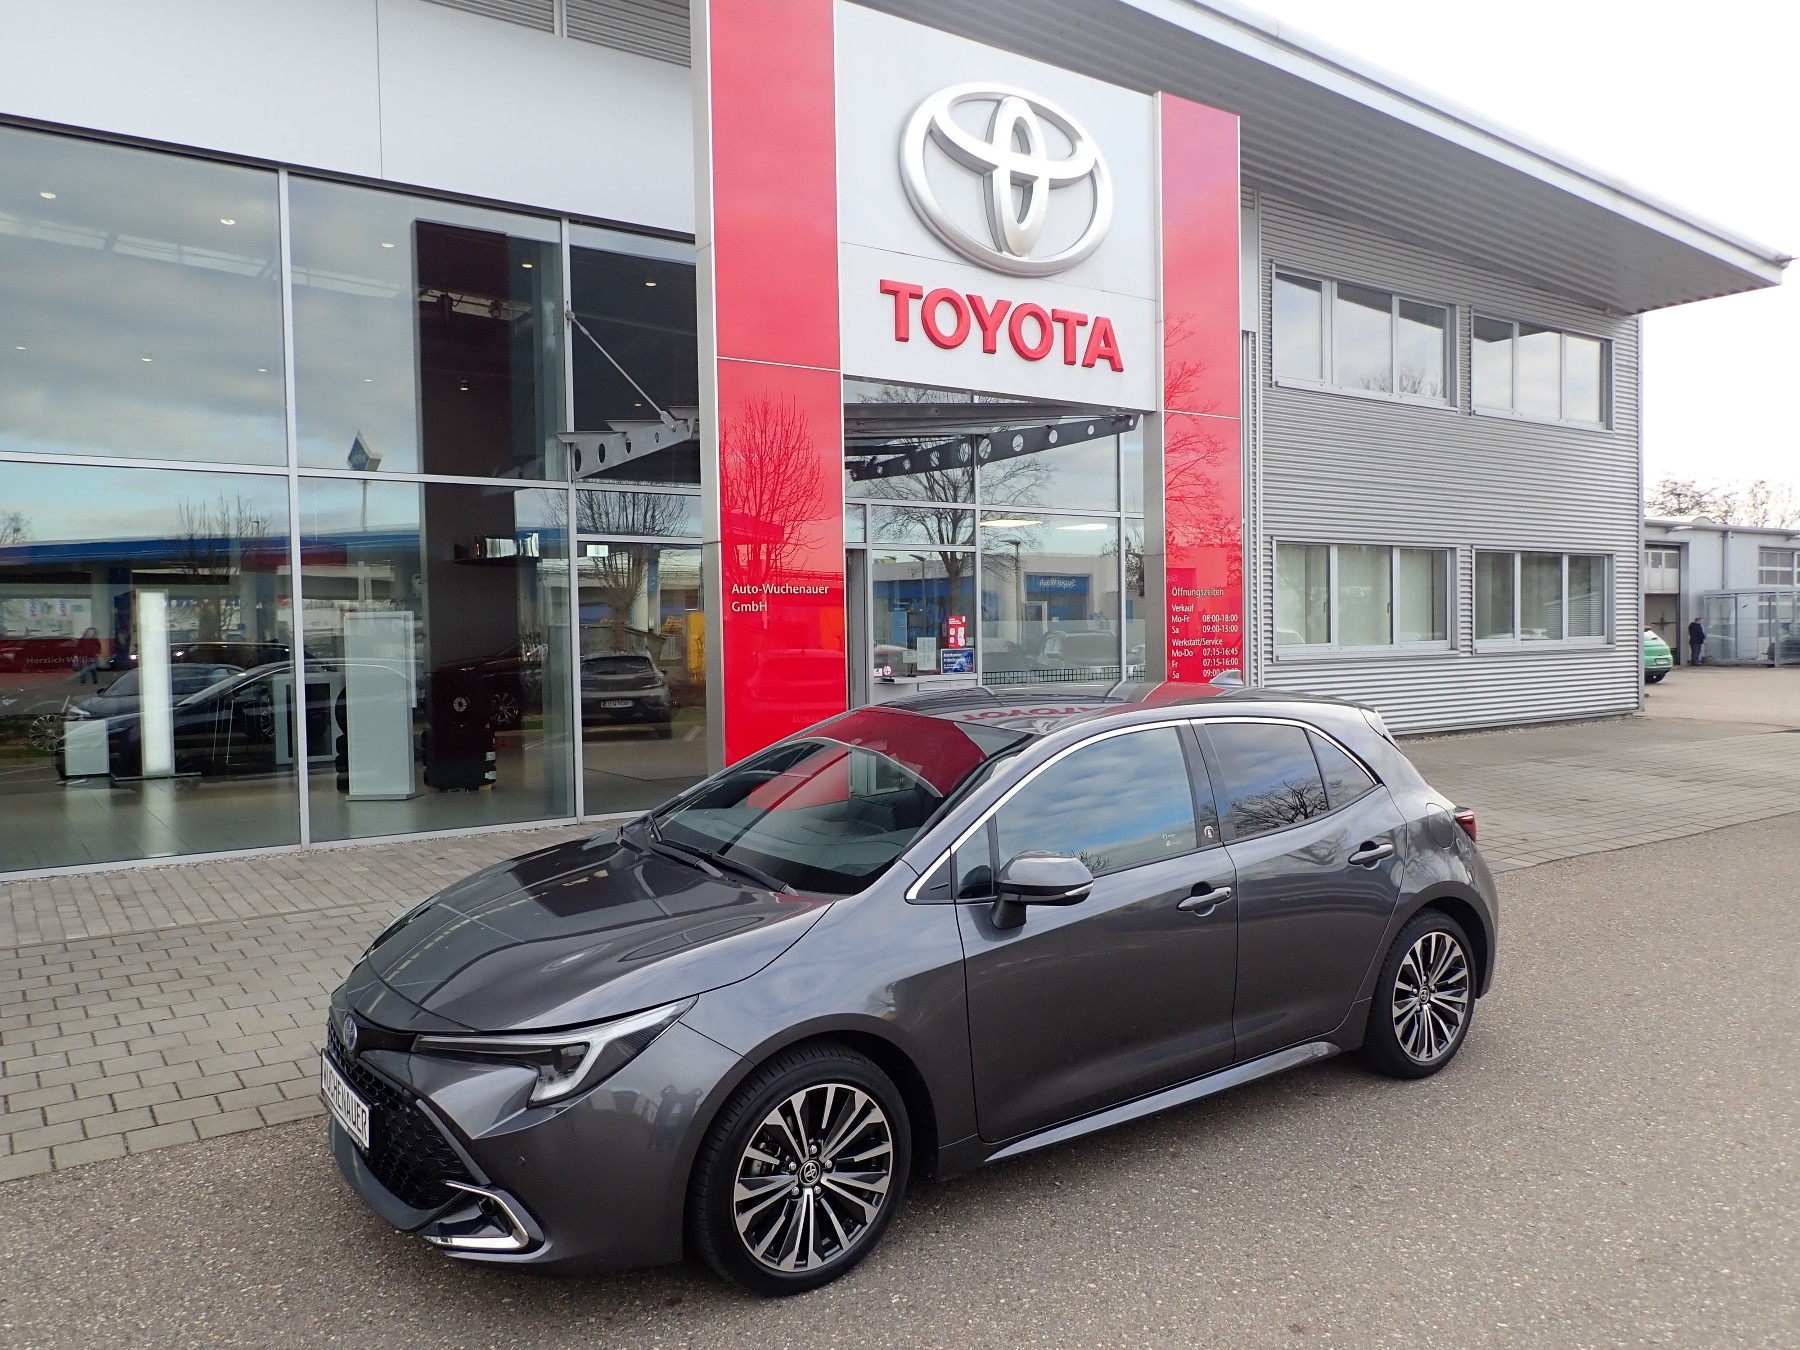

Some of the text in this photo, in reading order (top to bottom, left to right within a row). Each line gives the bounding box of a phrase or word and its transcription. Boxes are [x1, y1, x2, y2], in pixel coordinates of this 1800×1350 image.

[880, 279, 1124, 372] TOYOTA
[731, 583, 829, 595] Auto-Wuchenauer
[1171, 587, 1224, 598] Öffnungszeiten
[731, 601, 768, 612] GmbH
[1171, 603, 1194, 612] Verkauf
[1171, 614, 1238, 623] Mo-Fr 08:00-18:00
[1171, 626, 1180, 634] Sa
[1171, 637, 1223, 647] Werkstatt/Service
[1171, 649, 1193, 657] Mo-Do
[1171, 658, 1239, 668] Fr 07:15-16:00
[1172, 671, 1180, 679] Sa
